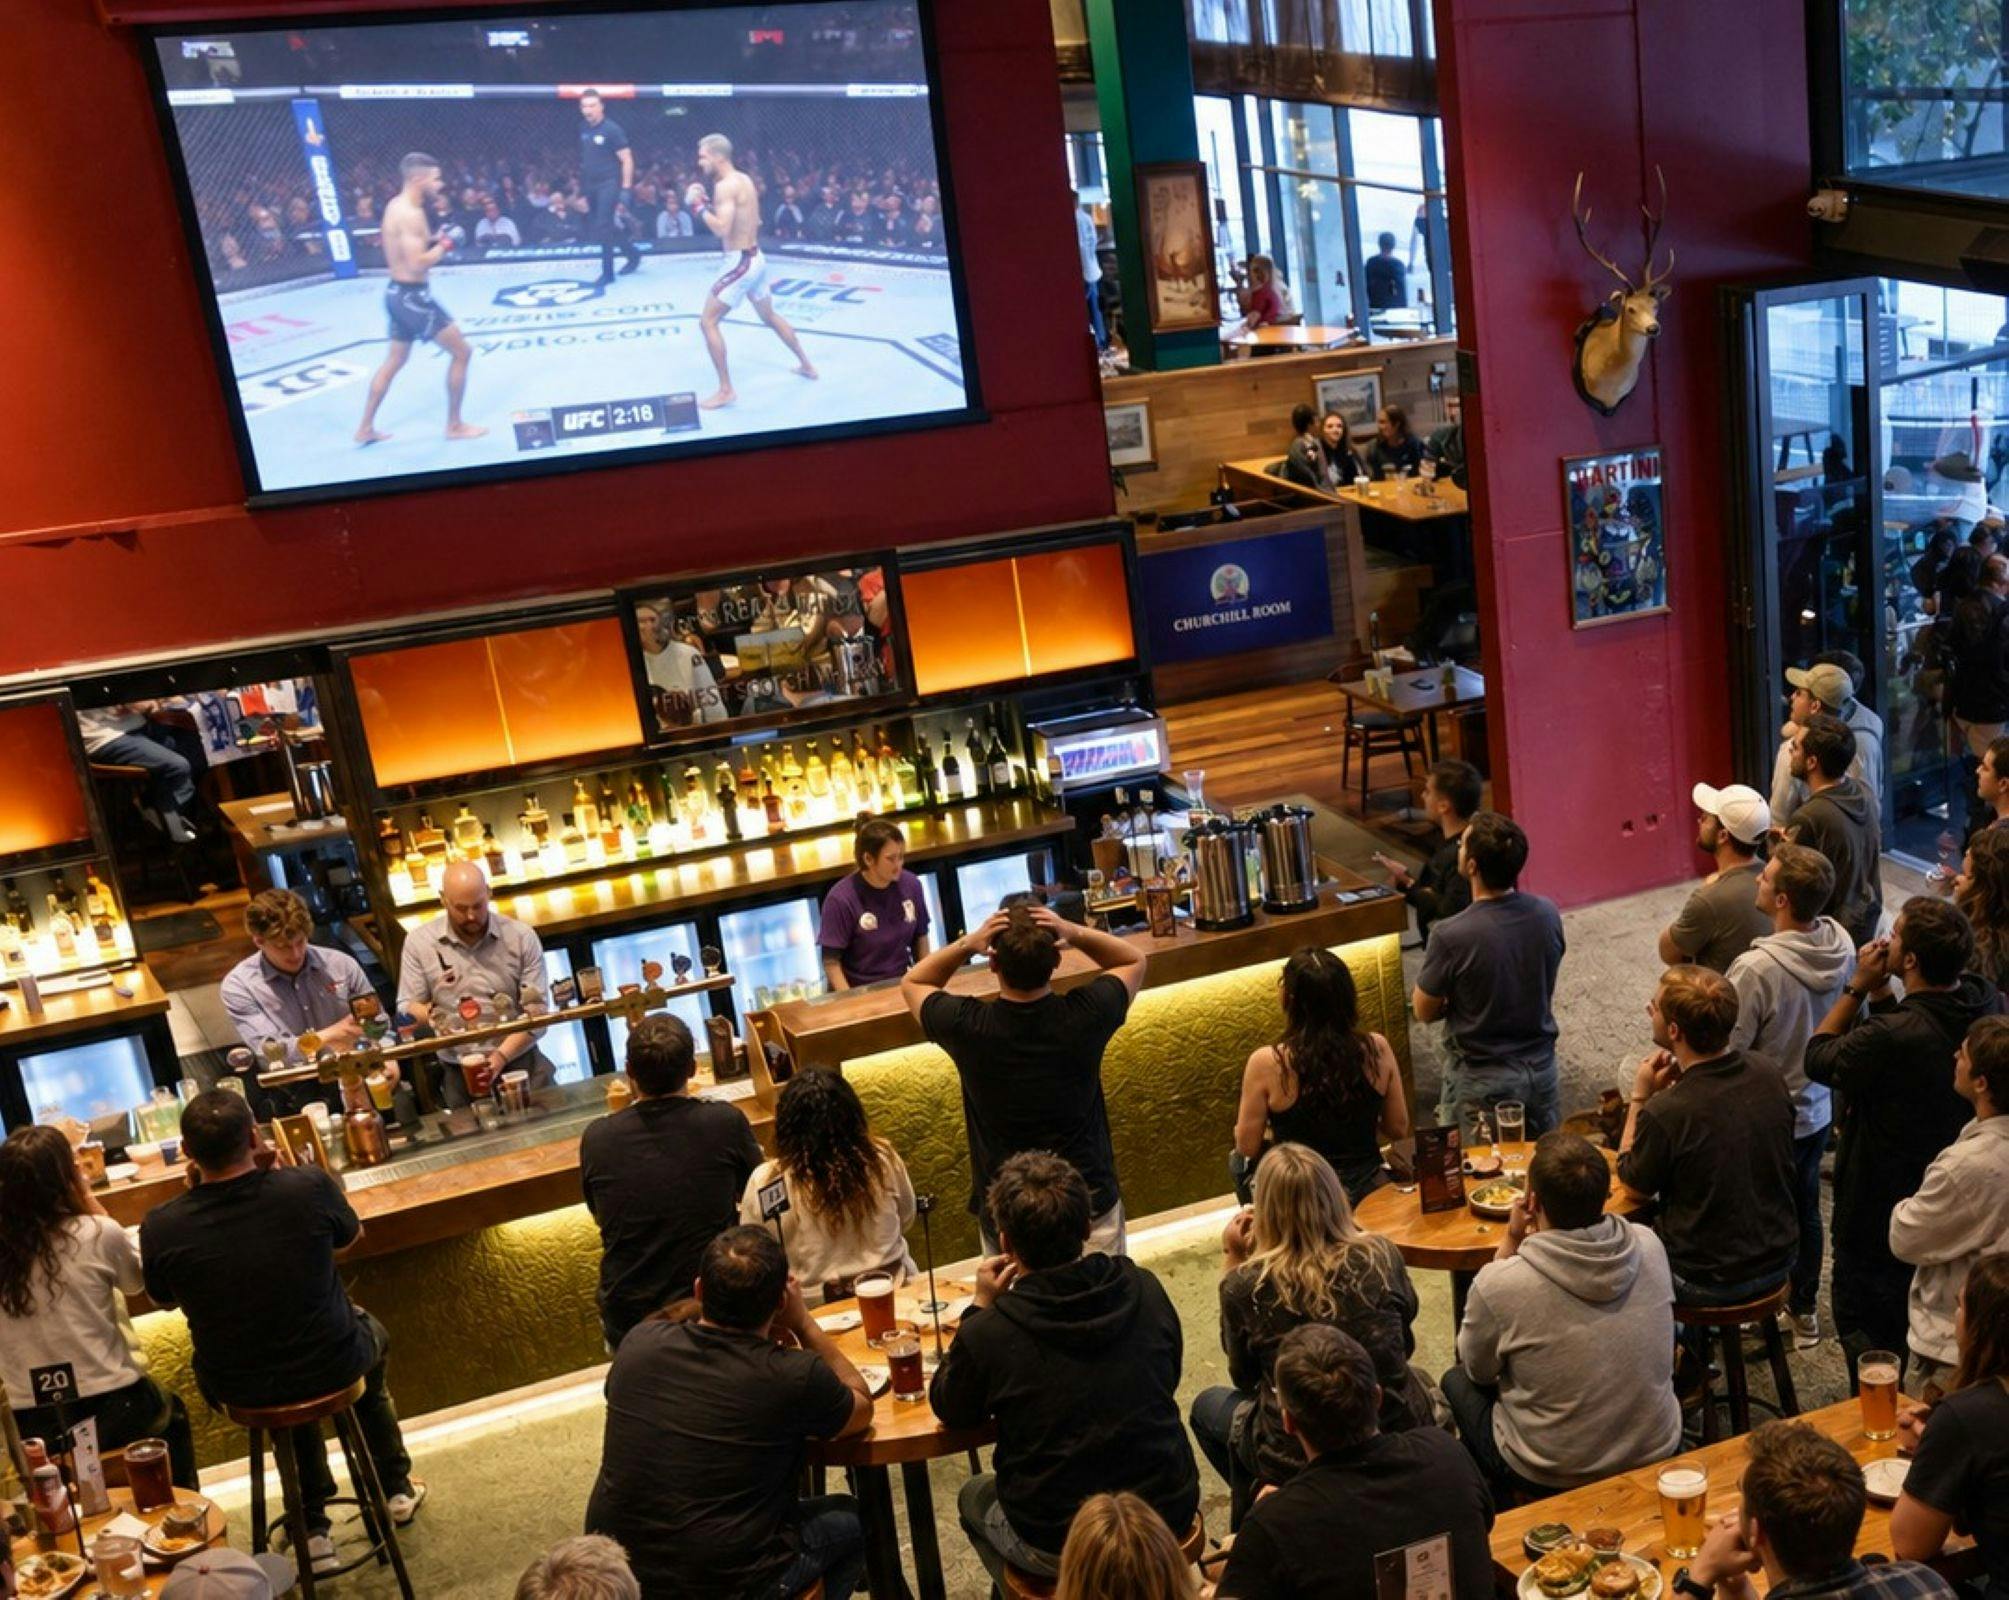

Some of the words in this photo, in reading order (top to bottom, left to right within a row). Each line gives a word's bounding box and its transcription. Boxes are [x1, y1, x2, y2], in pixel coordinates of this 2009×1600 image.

[563, 409, 604, 431] UFC
[613, 404, 653, 425] 2:18
[1576, 456, 1658, 492] MARTINI
[1174, 608, 1251, 632] CHURCHILL
[1252, 600, 1292, 619] ROOM
[39, 1371, 69, 1391] 20
